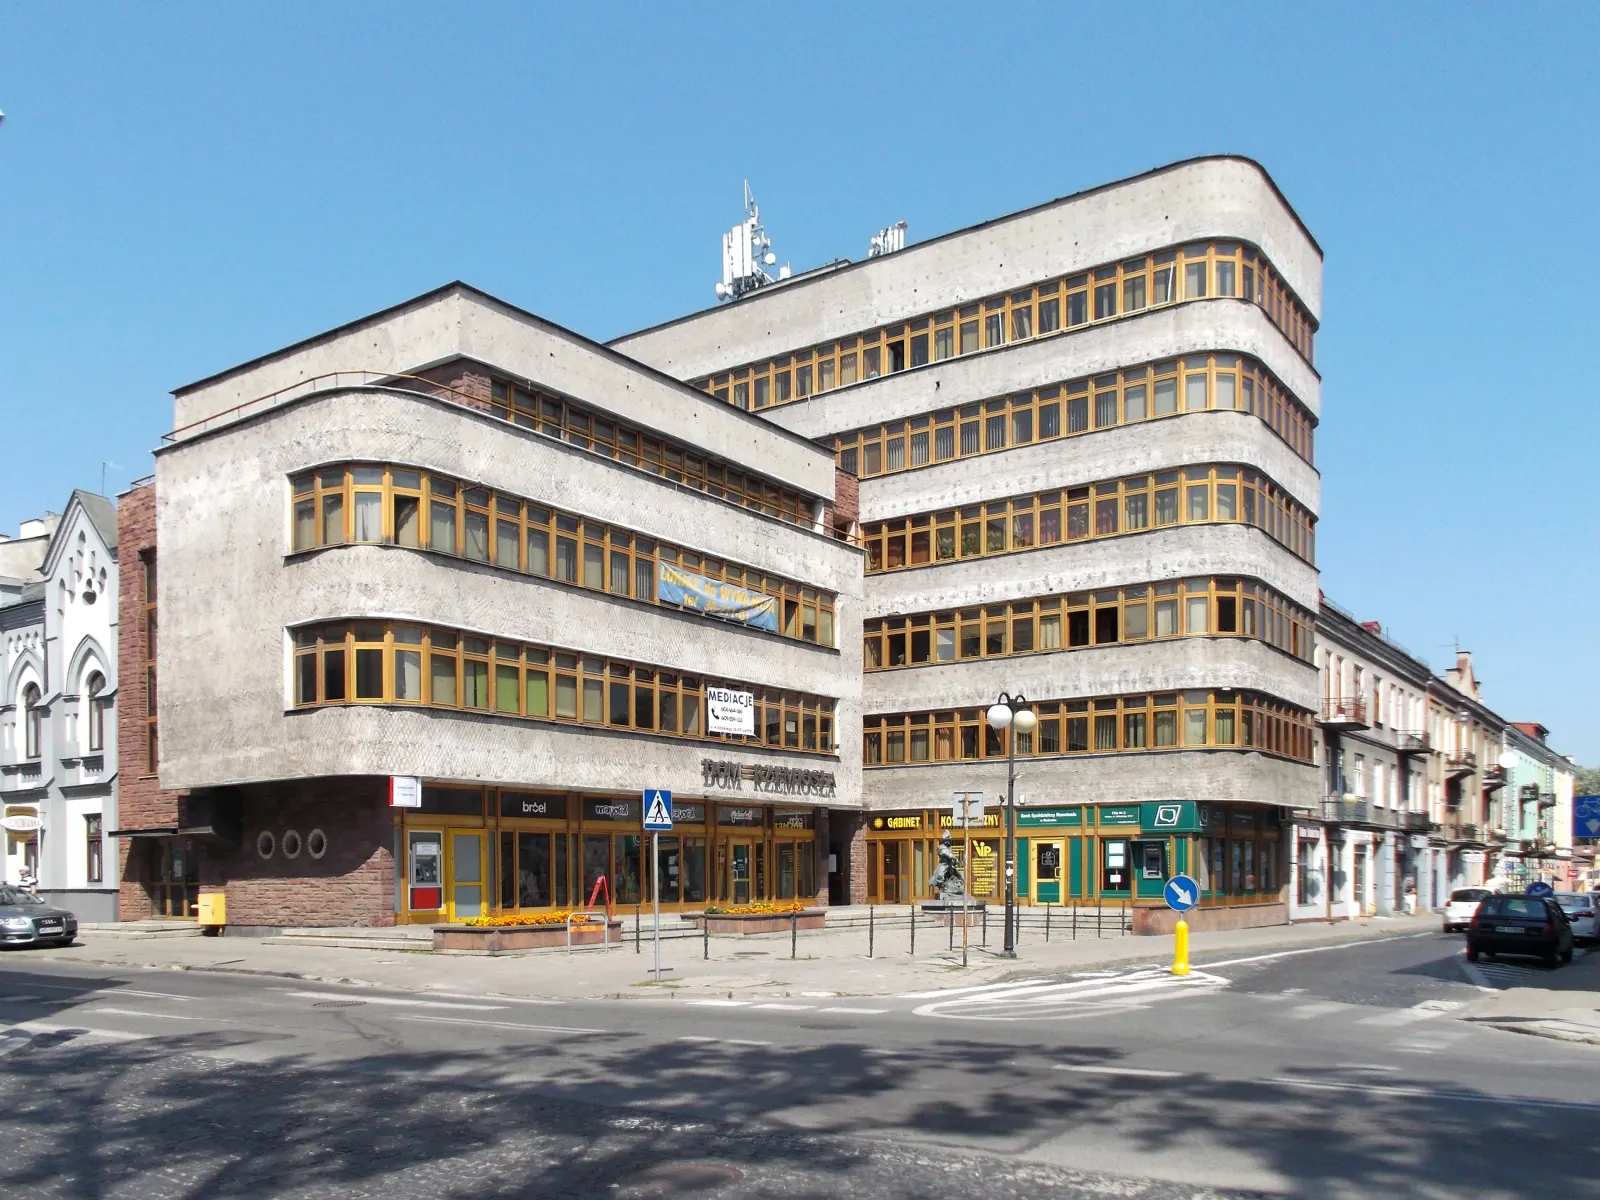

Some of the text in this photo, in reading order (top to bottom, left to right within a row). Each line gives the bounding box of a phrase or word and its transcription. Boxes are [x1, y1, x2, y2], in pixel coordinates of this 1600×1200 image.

[708, 690, 753, 707] MEDIACJE
[701, 759, 741, 785] DOM
[887, 816, 921, 828] GABINET
